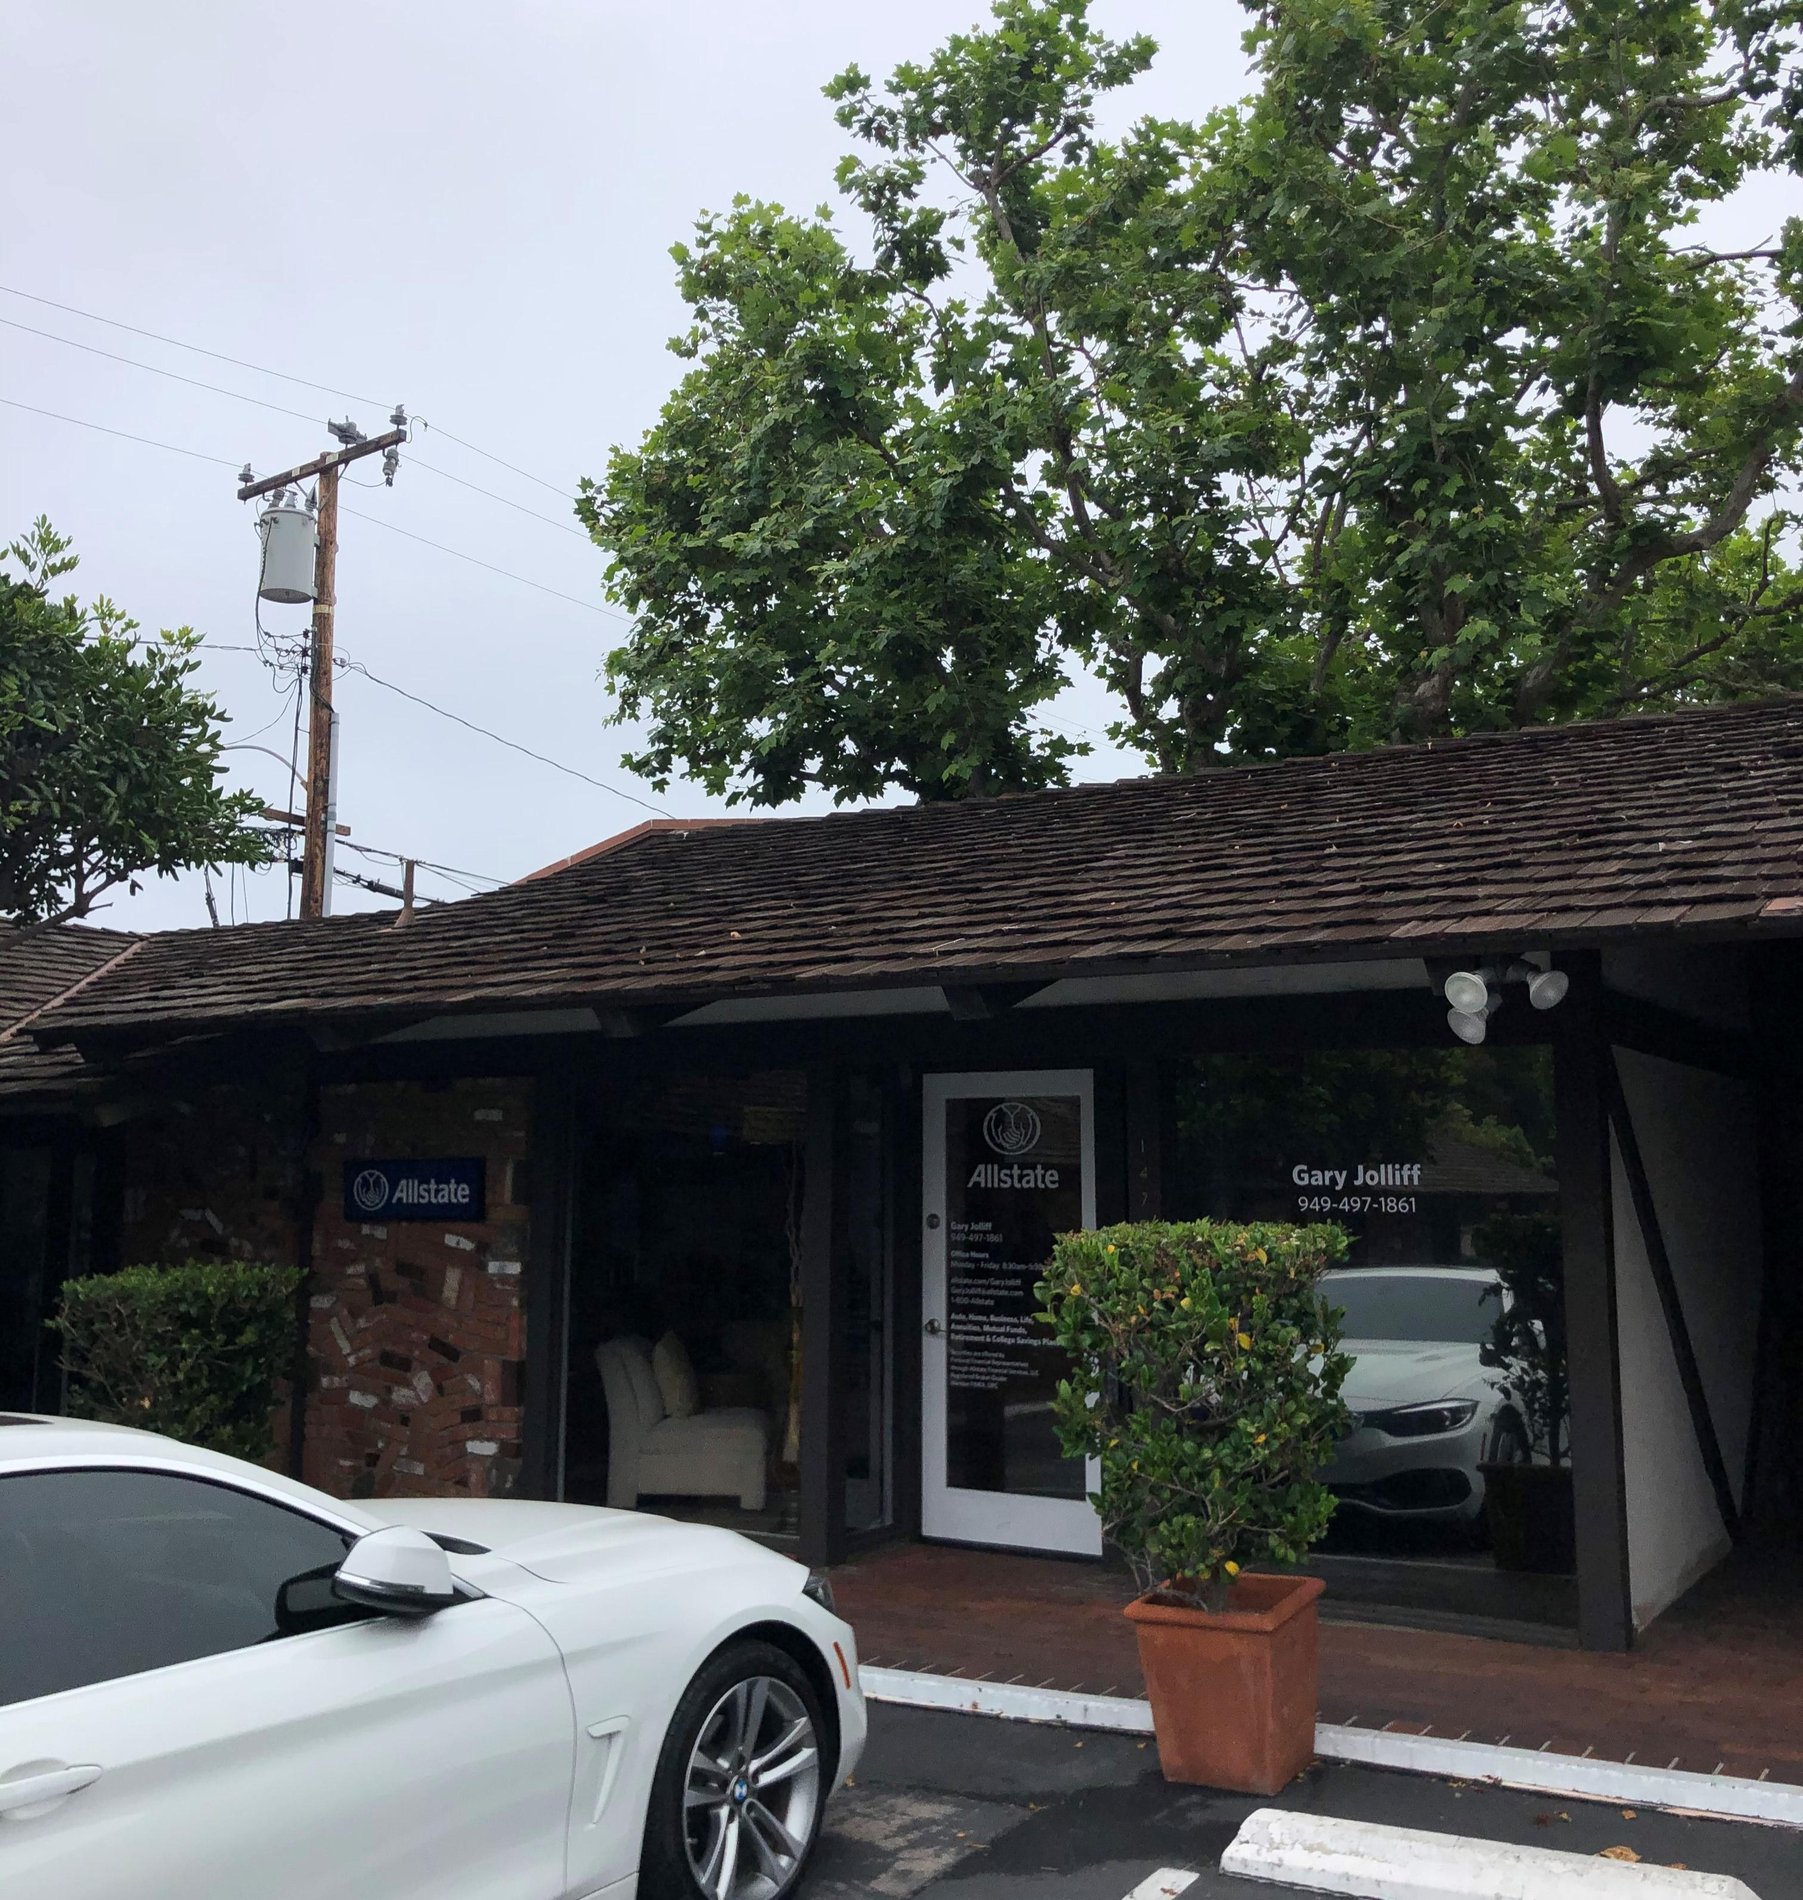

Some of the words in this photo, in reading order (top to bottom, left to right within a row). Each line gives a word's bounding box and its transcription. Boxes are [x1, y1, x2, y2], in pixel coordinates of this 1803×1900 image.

[967, 1164, 1059, 1188] Allstate
[1292, 1164, 1347, 1190] Gary
[1353, 1163, 1421, 1186] Jolliff
[392, 1178, 470, 1204] Allstate
[1297, 1196, 1416, 1213] 949-497-1861
[951, 1222, 968, 1232] Gary
[970, 1222, 992, 1231] Jolliff
[951, 1232, 1003, 1242] 949-497-1861
